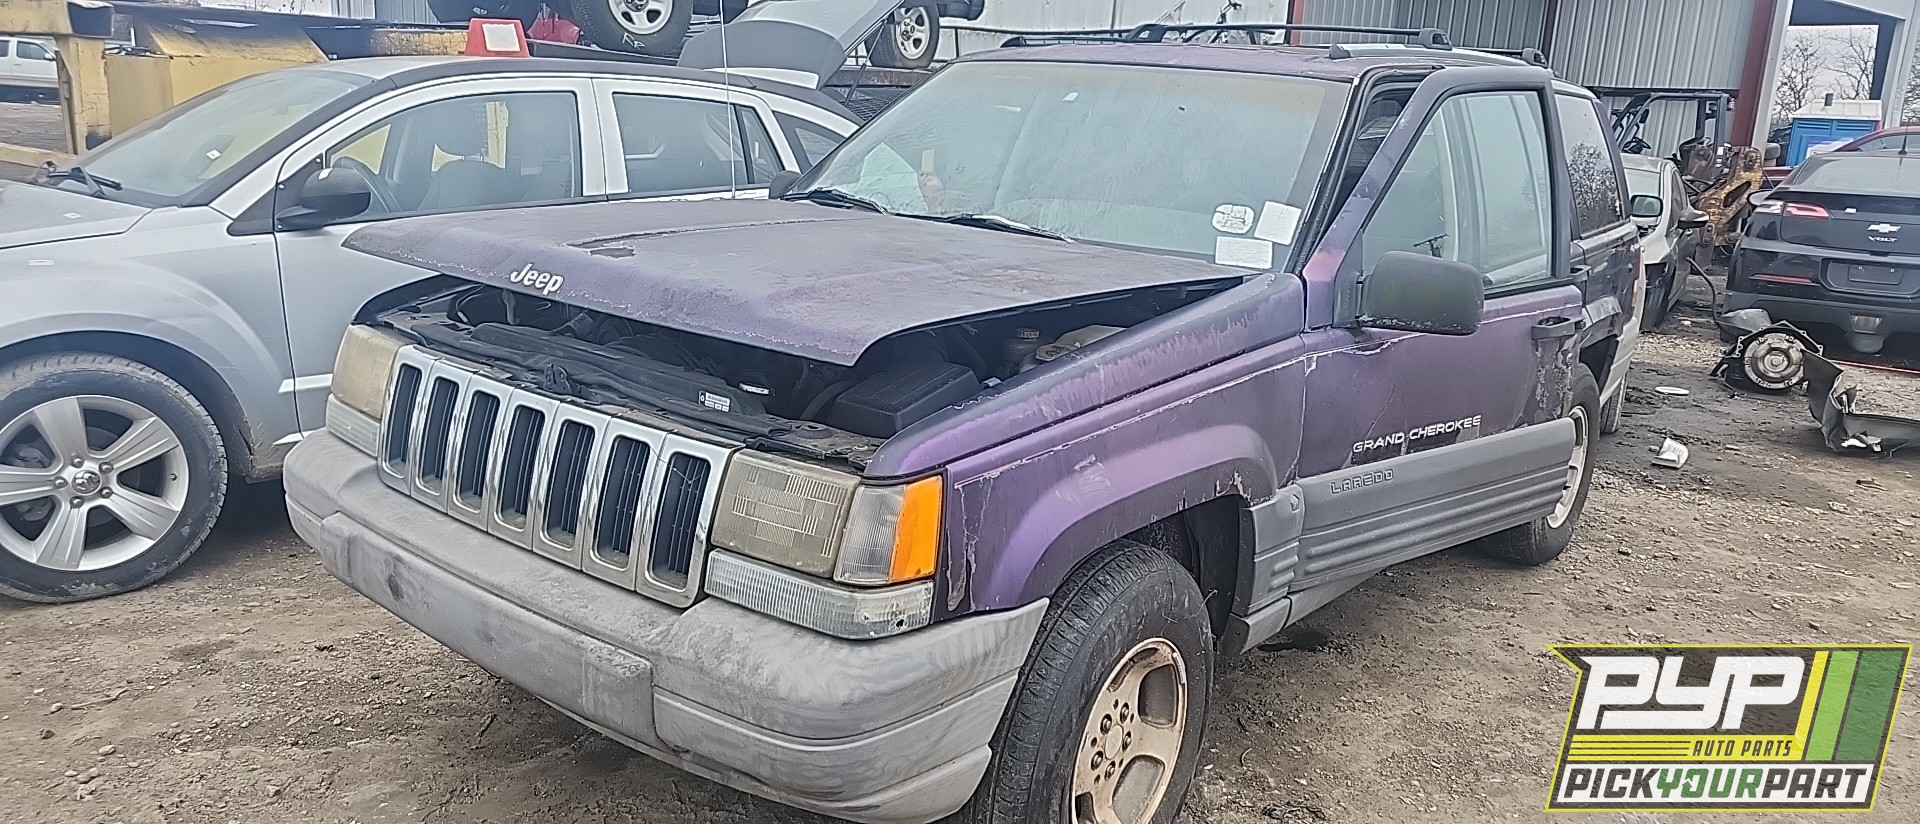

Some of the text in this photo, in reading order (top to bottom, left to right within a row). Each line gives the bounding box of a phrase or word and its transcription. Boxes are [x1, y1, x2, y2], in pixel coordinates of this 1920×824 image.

[510, 263, 563, 295] Jeep
[1352, 415, 1481, 453] GRAND CHEROKEE
[1330, 469, 1394, 494] LAREDO
